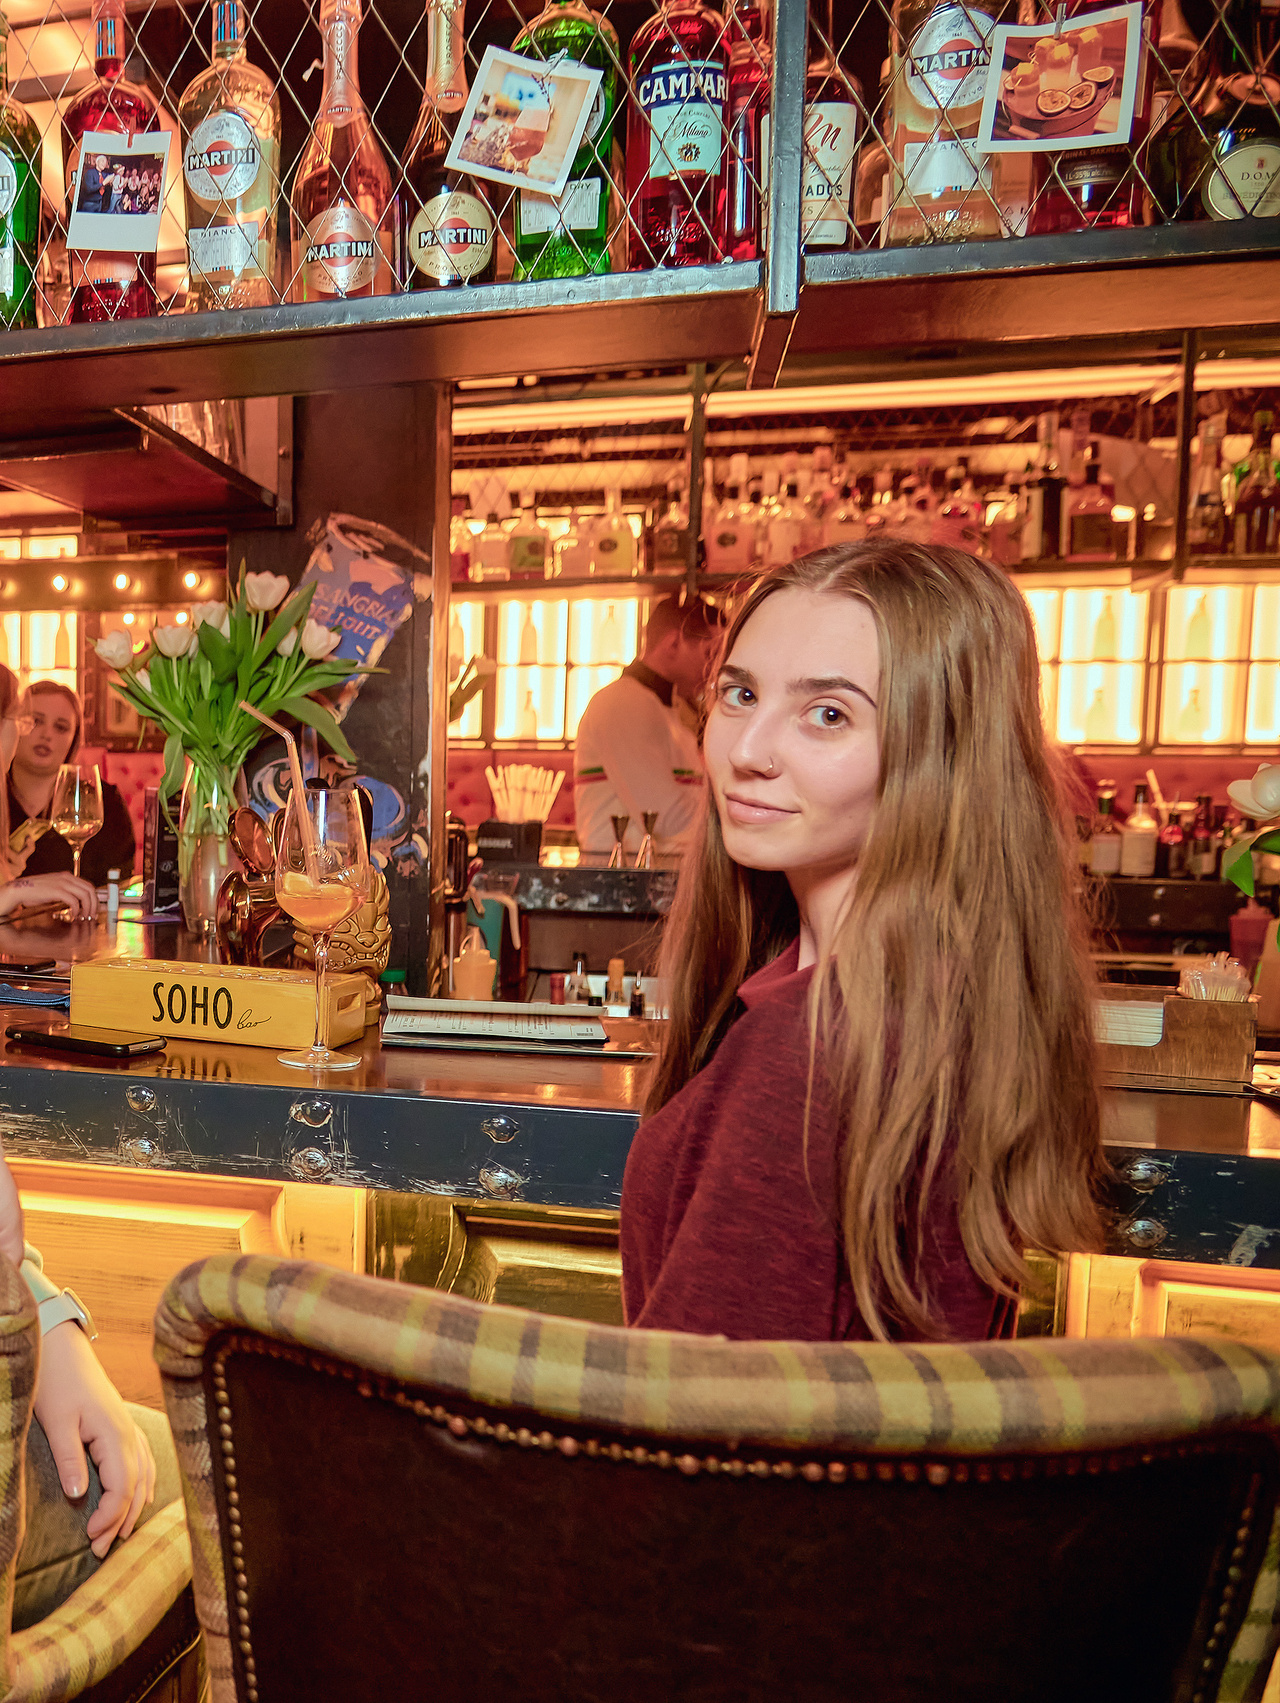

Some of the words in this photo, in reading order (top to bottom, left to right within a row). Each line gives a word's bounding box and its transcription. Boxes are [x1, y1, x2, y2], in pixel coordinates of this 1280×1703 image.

[639, 72, 730, 107] CAMPARI
[189, 149, 254, 171] MARTINI
[420, 228, 486, 248] MARTINI
[307, 241, 373, 263] MARTINI
[152, 981, 233, 1030] SOHO
